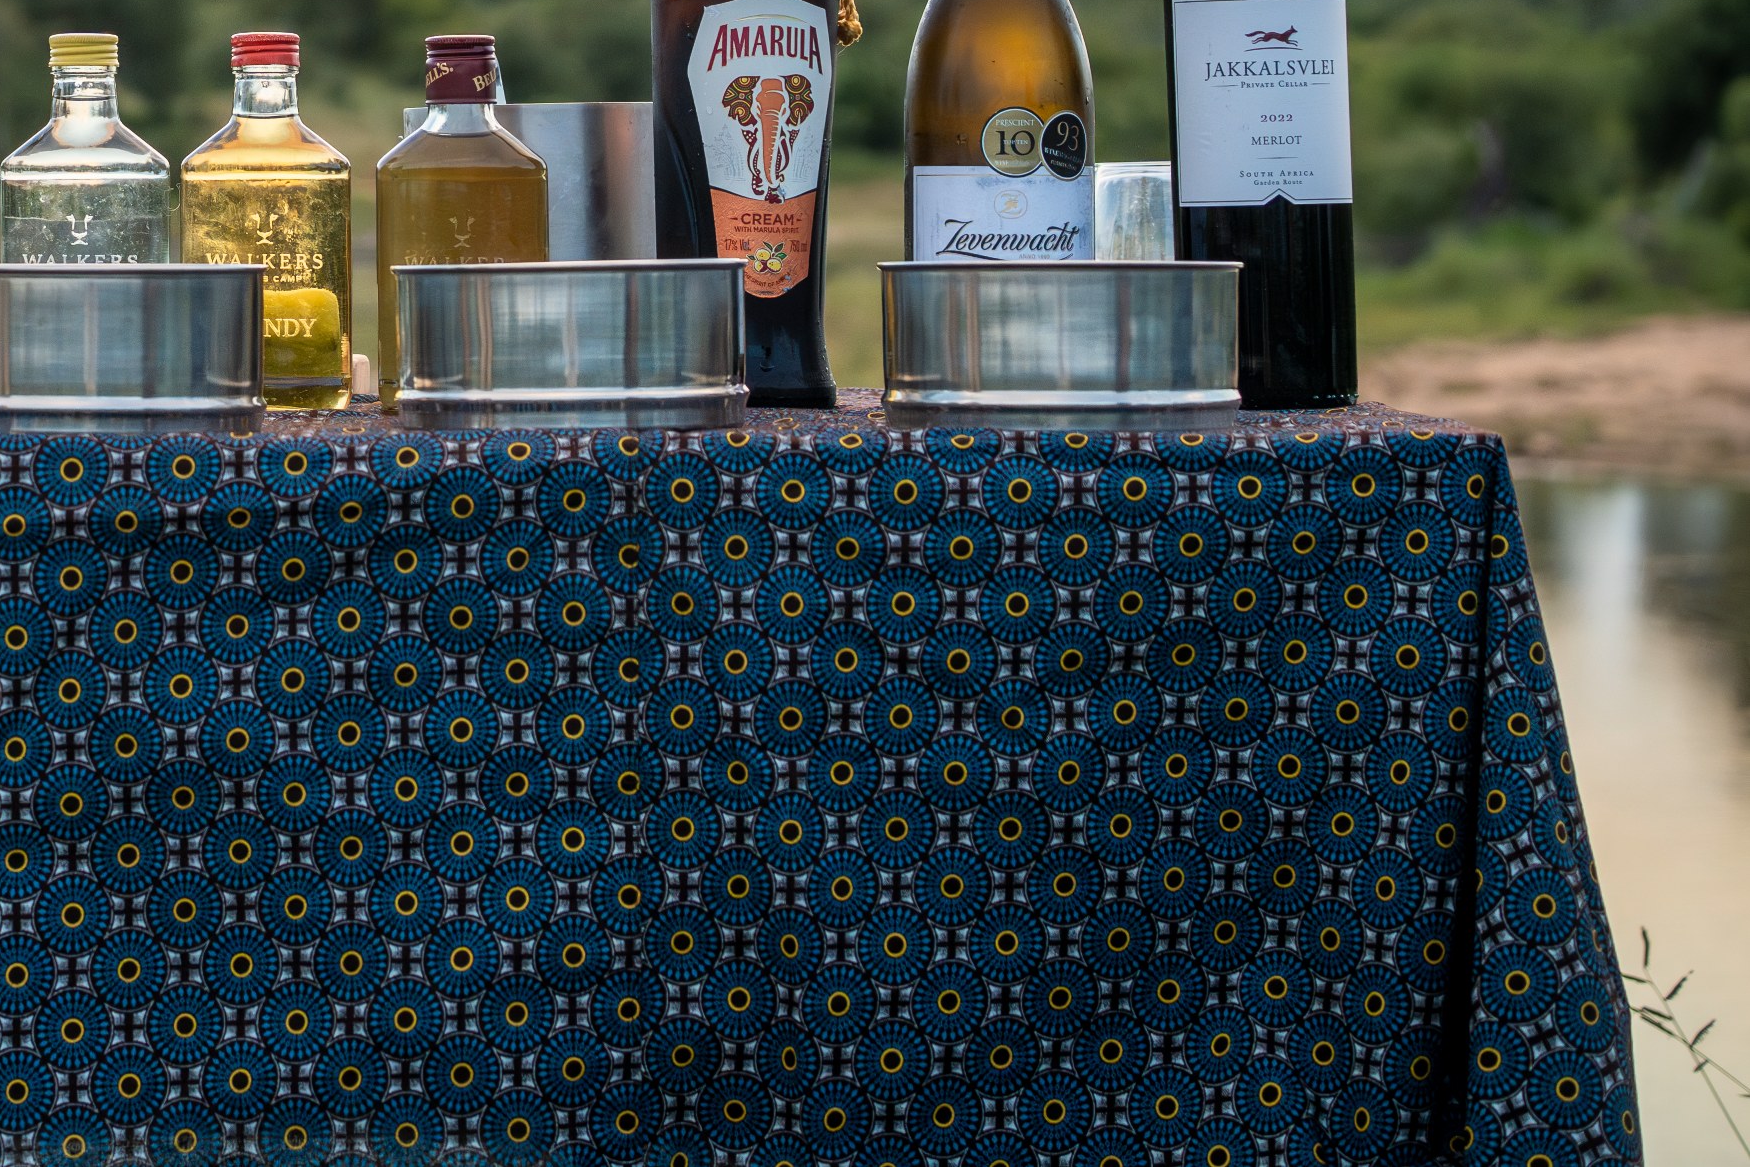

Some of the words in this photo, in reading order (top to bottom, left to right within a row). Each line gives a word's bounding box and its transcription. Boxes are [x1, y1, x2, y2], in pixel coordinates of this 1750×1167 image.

[707, 23, 824, 75] AMARULA
[1204, 59, 1335, 82] JAKKALSVLEI
[995, 119, 1035, 127] PRESCIENT
[1260, 113, 1293, 123] 2022
[995, 130, 1035, 156] 10
[1056, 121, 1080, 151] 93
[1251, 135, 1302, 146] MERLOT
[740, 213, 794, 226] CREAM
[753, 226, 781, 234] MARULA
[935, 220, 1080, 258] Zevenwacht
[206, 253, 324, 270] WALKERS
